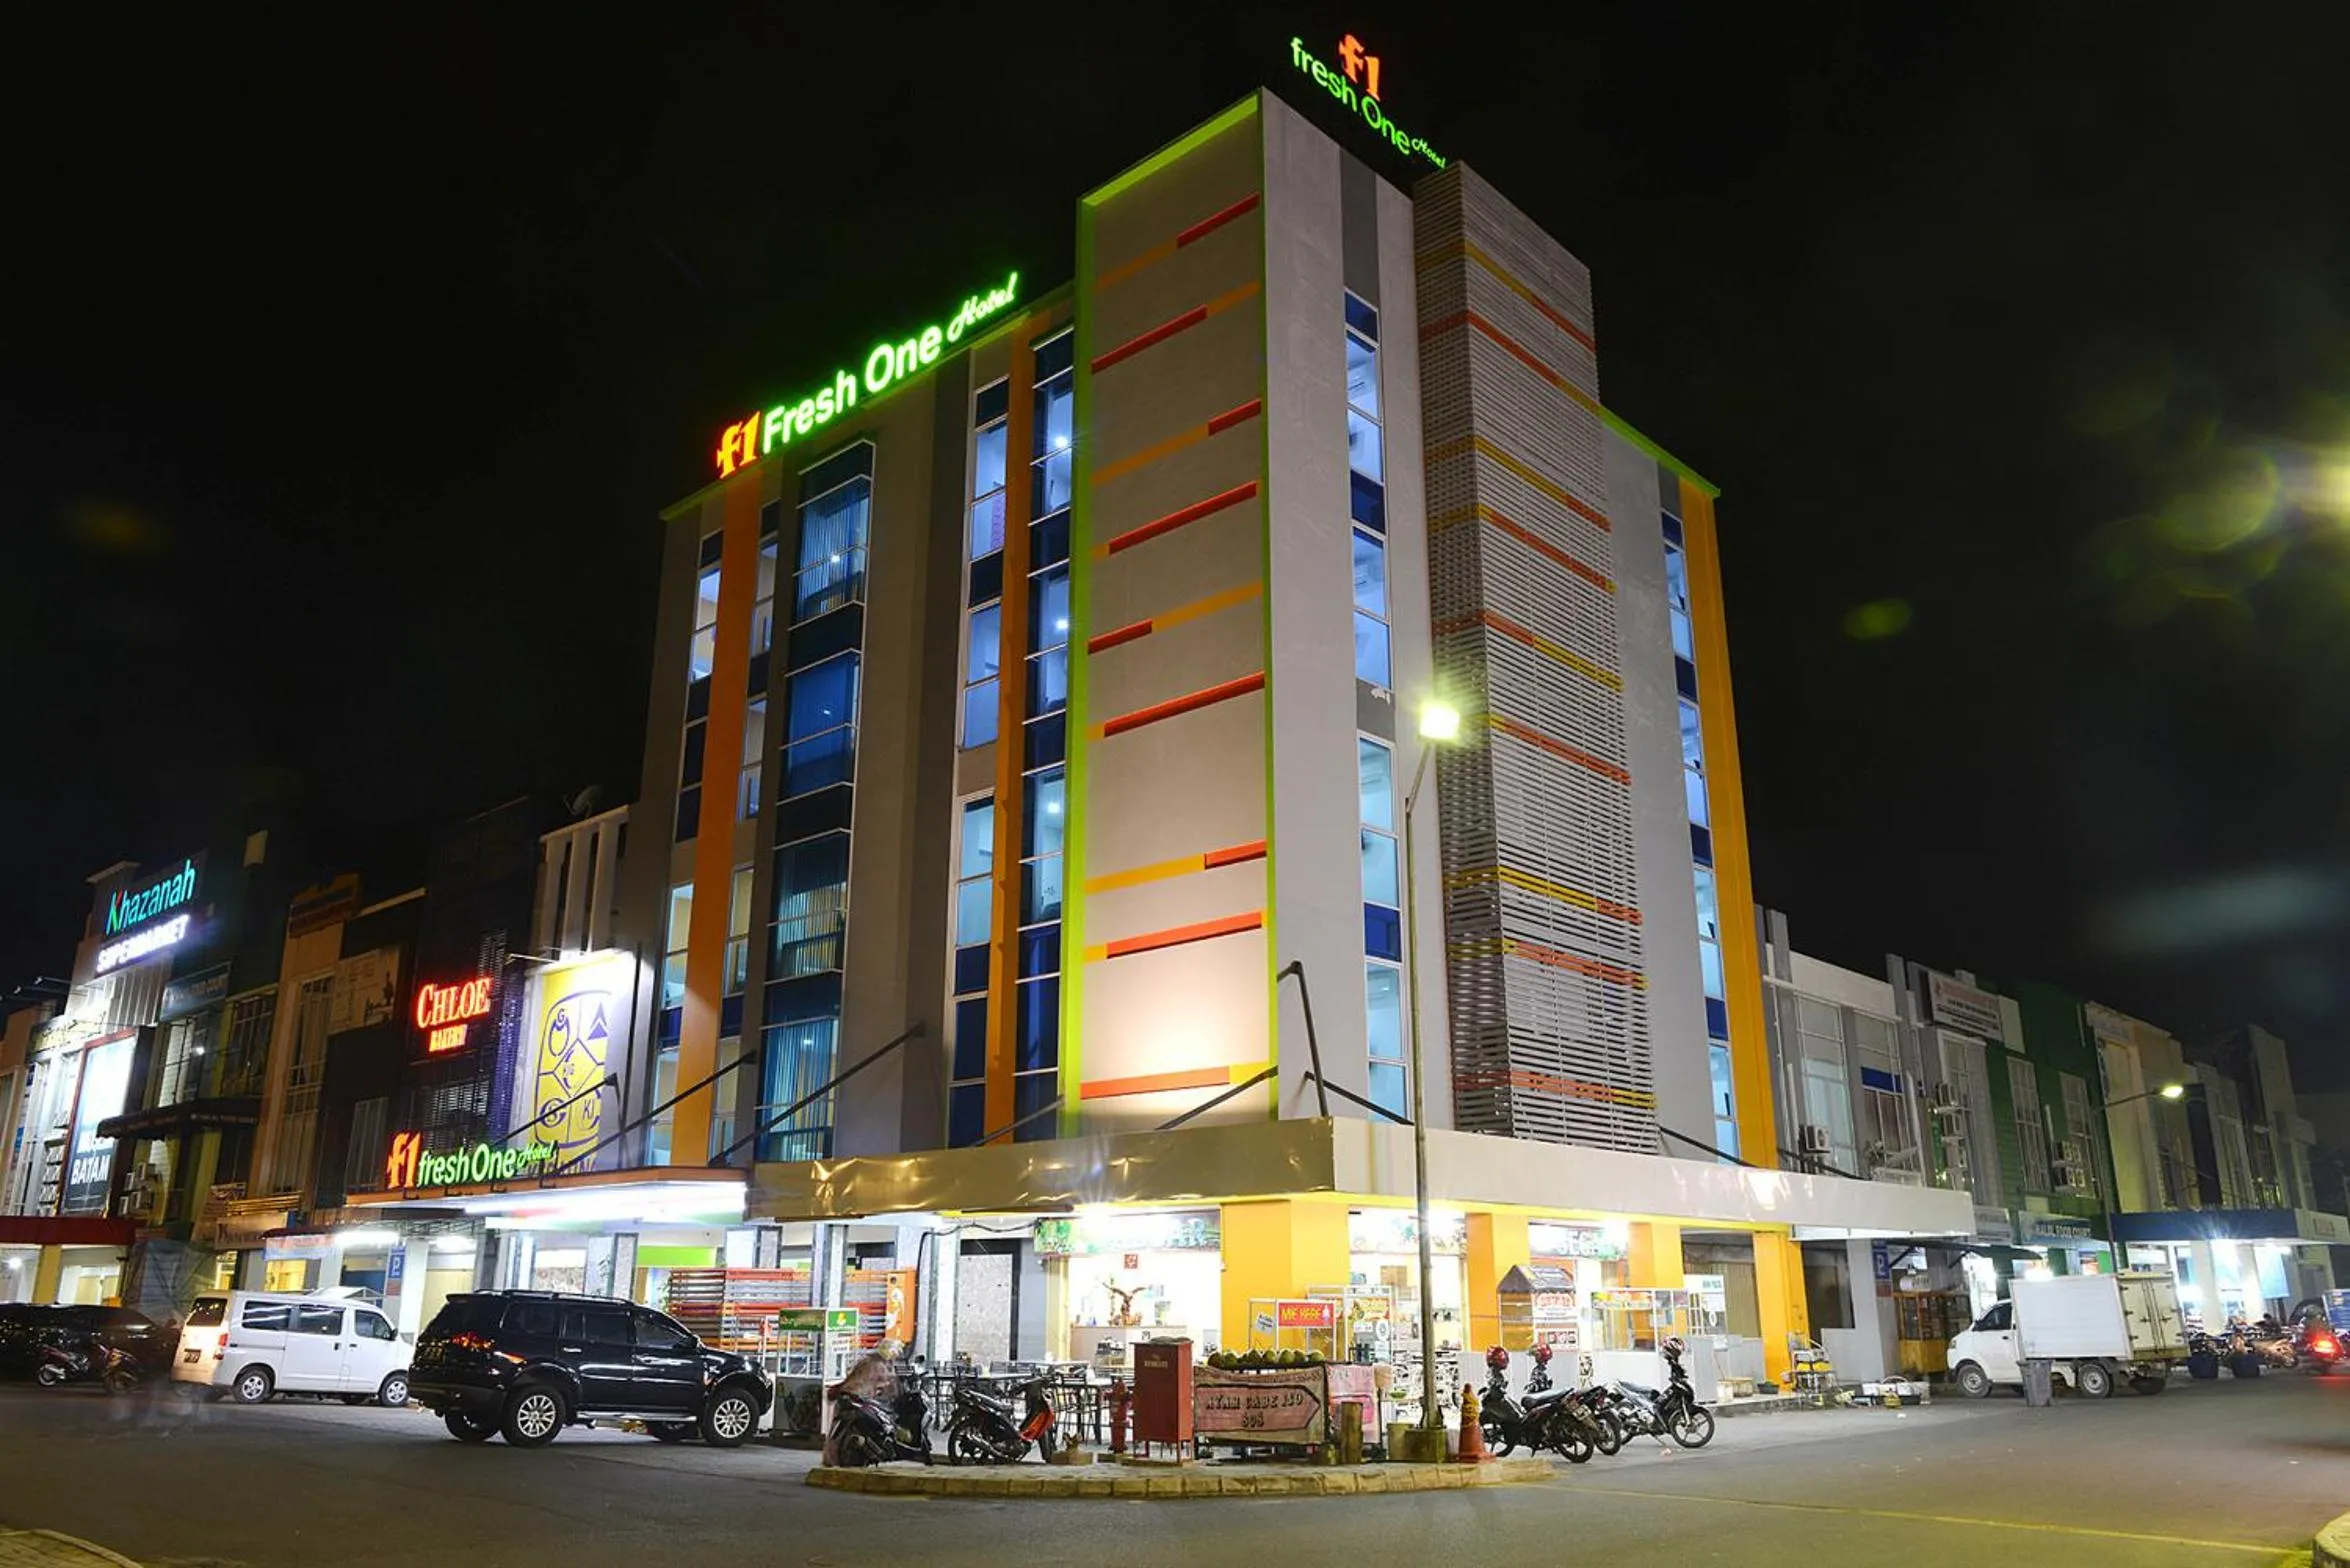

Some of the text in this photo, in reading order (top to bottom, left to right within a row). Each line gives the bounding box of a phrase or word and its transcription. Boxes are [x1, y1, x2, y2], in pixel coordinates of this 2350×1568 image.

[1290, 37, 1447, 169] fresh One Hotel
[1338, 34, 1380, 101] f1
[716, 271, 1019, 479] f1 Fresh One Hotel
[106, 859, 196, 936] Khazanah
[70, 1154, 111, 1185] BATAM
[387, 1131, 421, 1189] f1
[417, 1146, 471, 1187] fresh
[471, 1142, 516, 1183] One
[516, 1140, 555, 1168] Hotel
